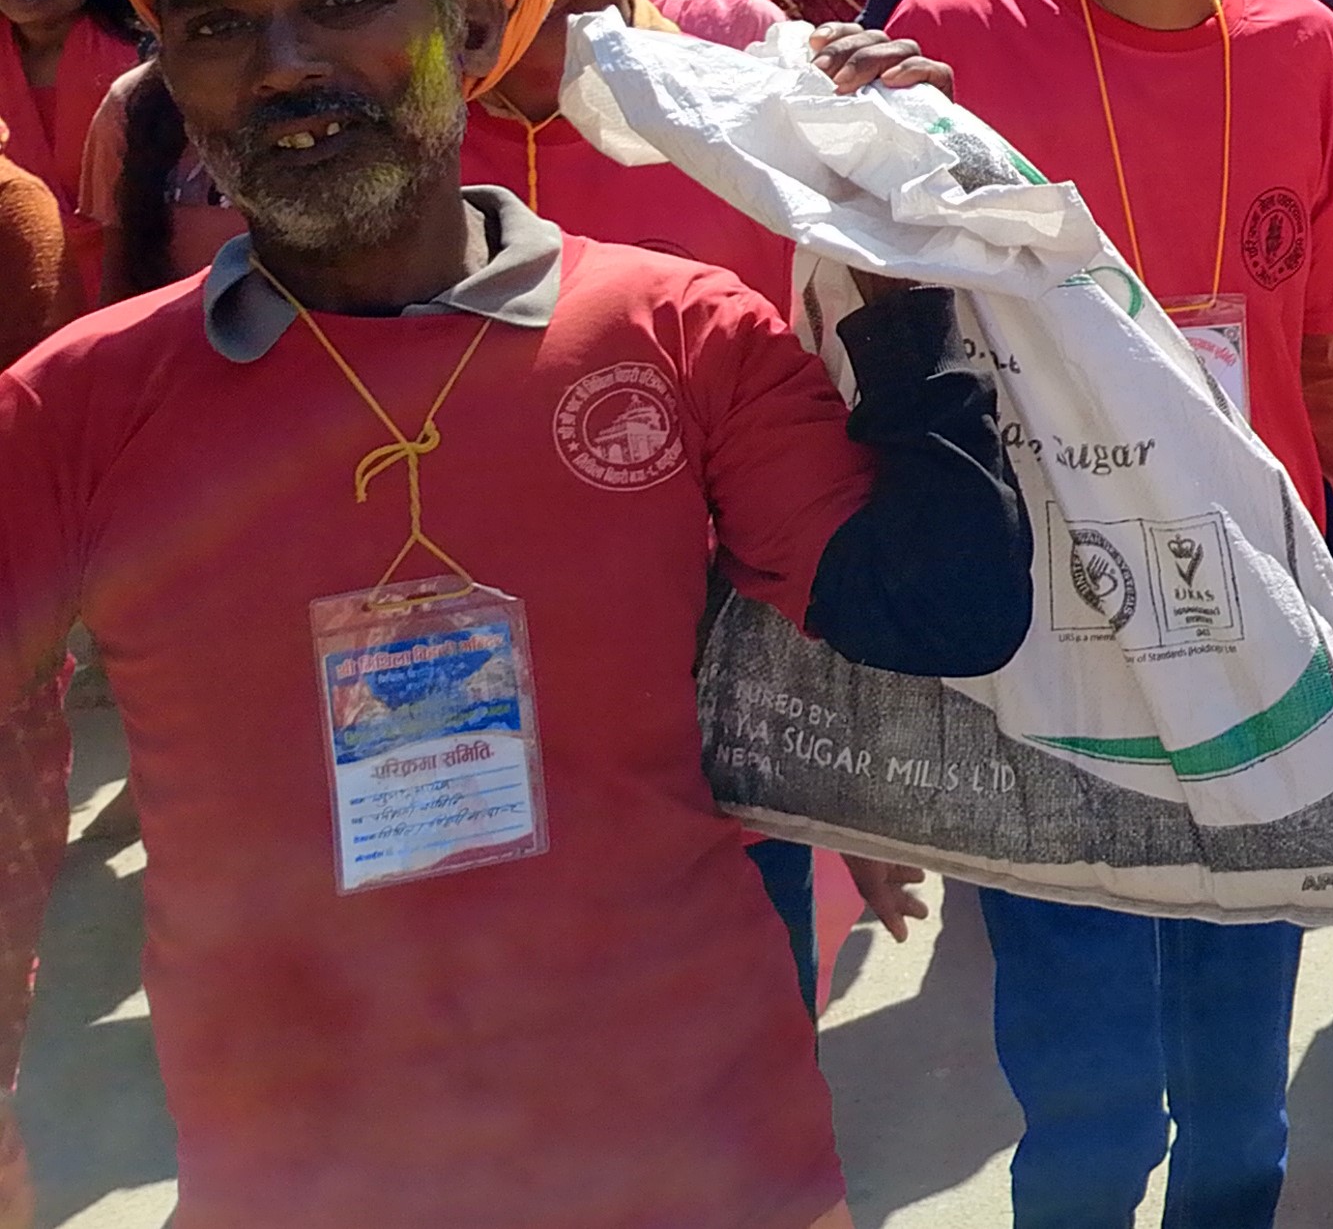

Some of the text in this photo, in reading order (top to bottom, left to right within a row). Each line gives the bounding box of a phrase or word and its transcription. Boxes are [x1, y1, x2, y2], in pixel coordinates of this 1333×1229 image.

[715, 744, 785, 779] NEPAL
[783, 726, 872, 778] SUGAR
[971, 760, 1017, 794] LTD
